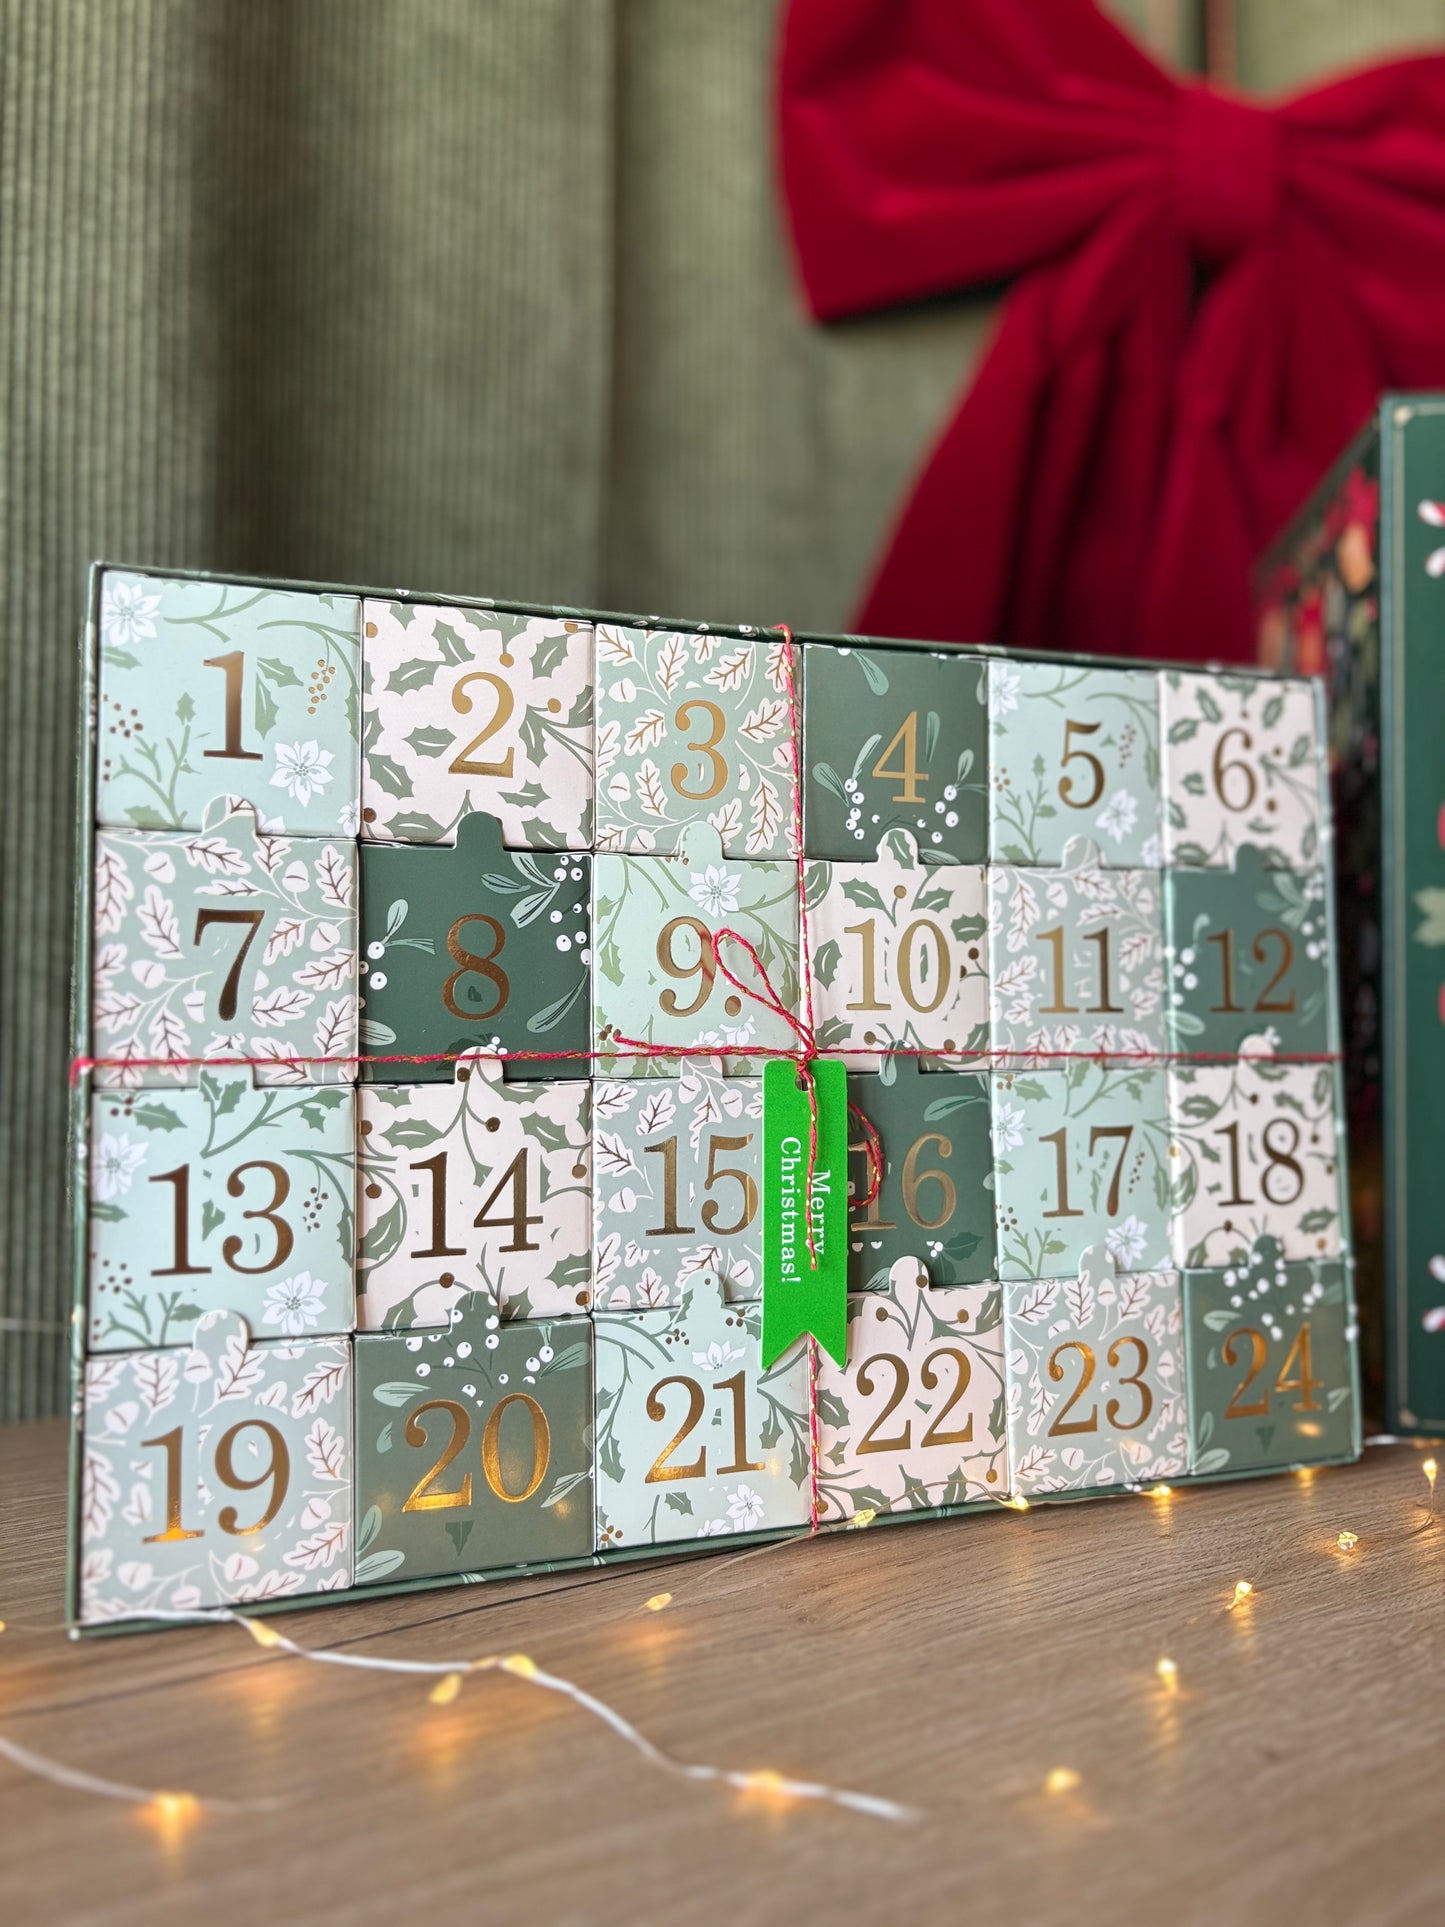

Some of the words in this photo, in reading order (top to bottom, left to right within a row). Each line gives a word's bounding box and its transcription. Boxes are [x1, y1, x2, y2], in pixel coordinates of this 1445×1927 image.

[203, 651, 263, 761] 1
[448, 671, 515, 779] 2
[670, 700, 728, 800] 3
[872, 711, 929, 804] 4
[1058, 719, 1106, 809] 5
[1212, 728, 1258, 812] 6
[193, 908, 265, 1021] 7
[442, 913, 510, 1021] 8
[656, 915, 717, 1017] 9
[844, 918, 951, 1013] 10
[1035, 925, 1124, 1015] 11
[1206, 928, 1297, 1014] 12
[410, 1147, 544, 1259] 14
[644, 1133, 759, 1236] 15
[781, 1136, 802, 1283] Christmas!
[806, 1169, 831, 1254] Merry
[847, 1132, 958, 1232] 16
[1039, 1124, 1134, 1218] 17
[1214, 1118, 1305, 1207] 18
[149, 1160, 294, 1277] 13
[856, 1347, 974, 1455] 22
[1047, 1336, 1154, 1438] 23
[1222, 1322, 1324, 1419] 24
[402, 1392, 552, 1513] 20
[645, 1370, 766, 1484] 21
[141, 1418, 291, 1544] 19
